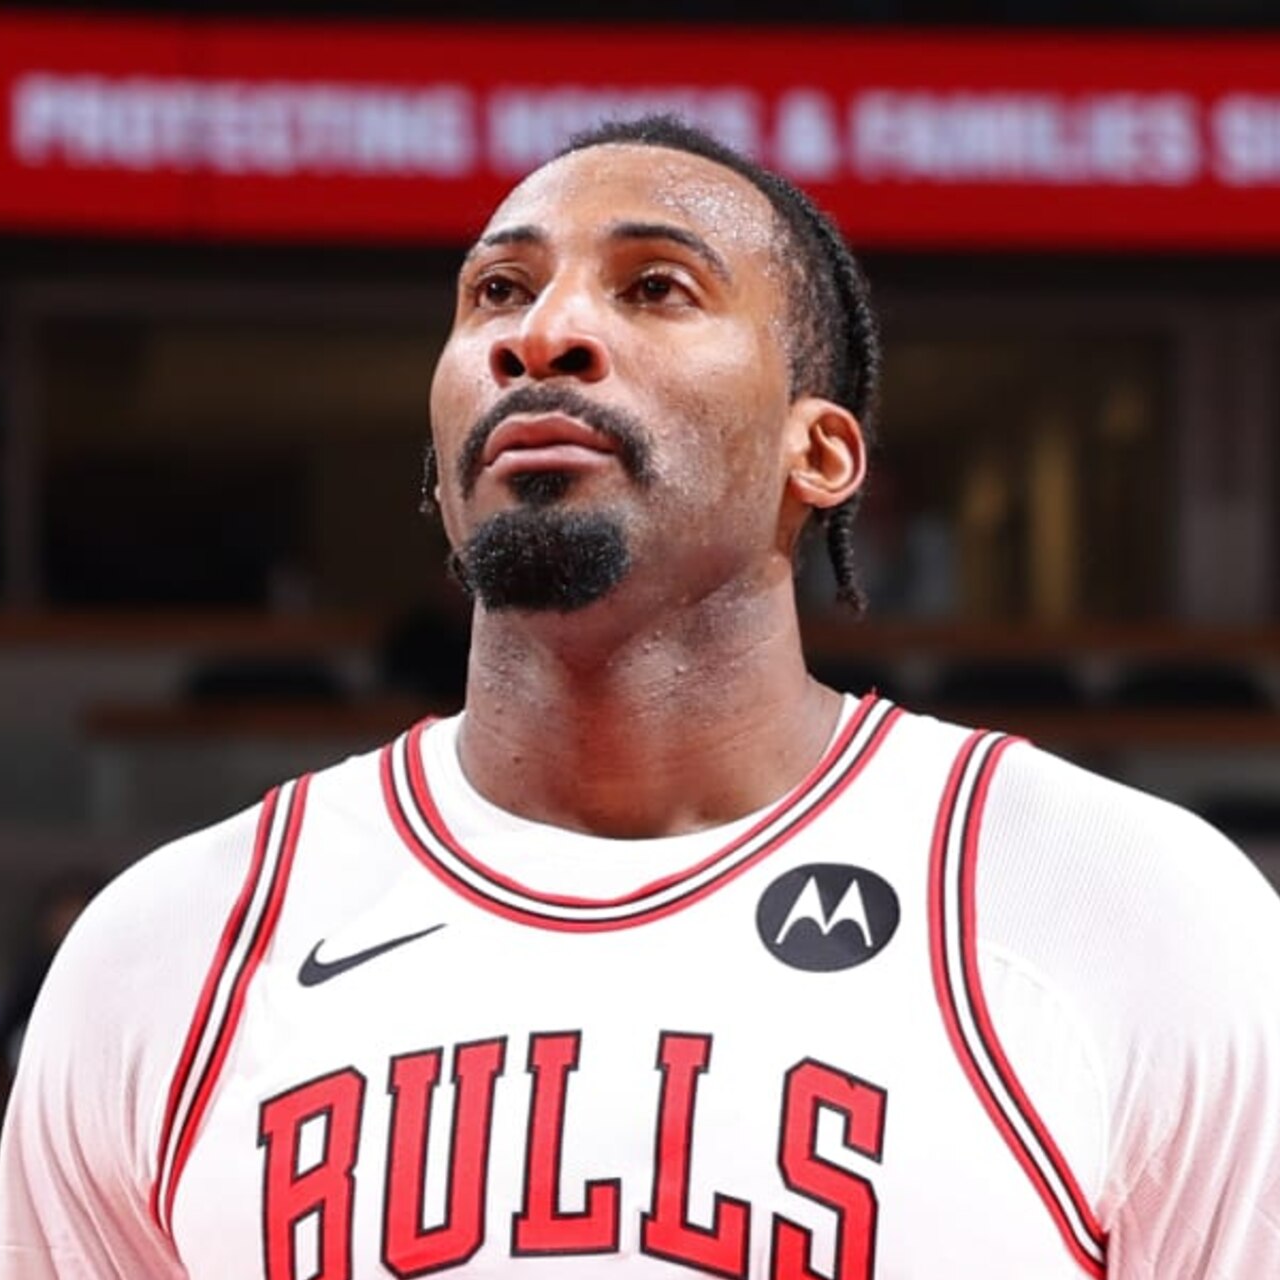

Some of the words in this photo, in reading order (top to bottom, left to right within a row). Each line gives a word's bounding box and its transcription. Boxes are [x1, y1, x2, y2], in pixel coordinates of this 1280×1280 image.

[13, 76, 475, 174] PROTECTING
[774, 93, 839, 181] &
[850, 93, 1202, 182] FAMILIES
